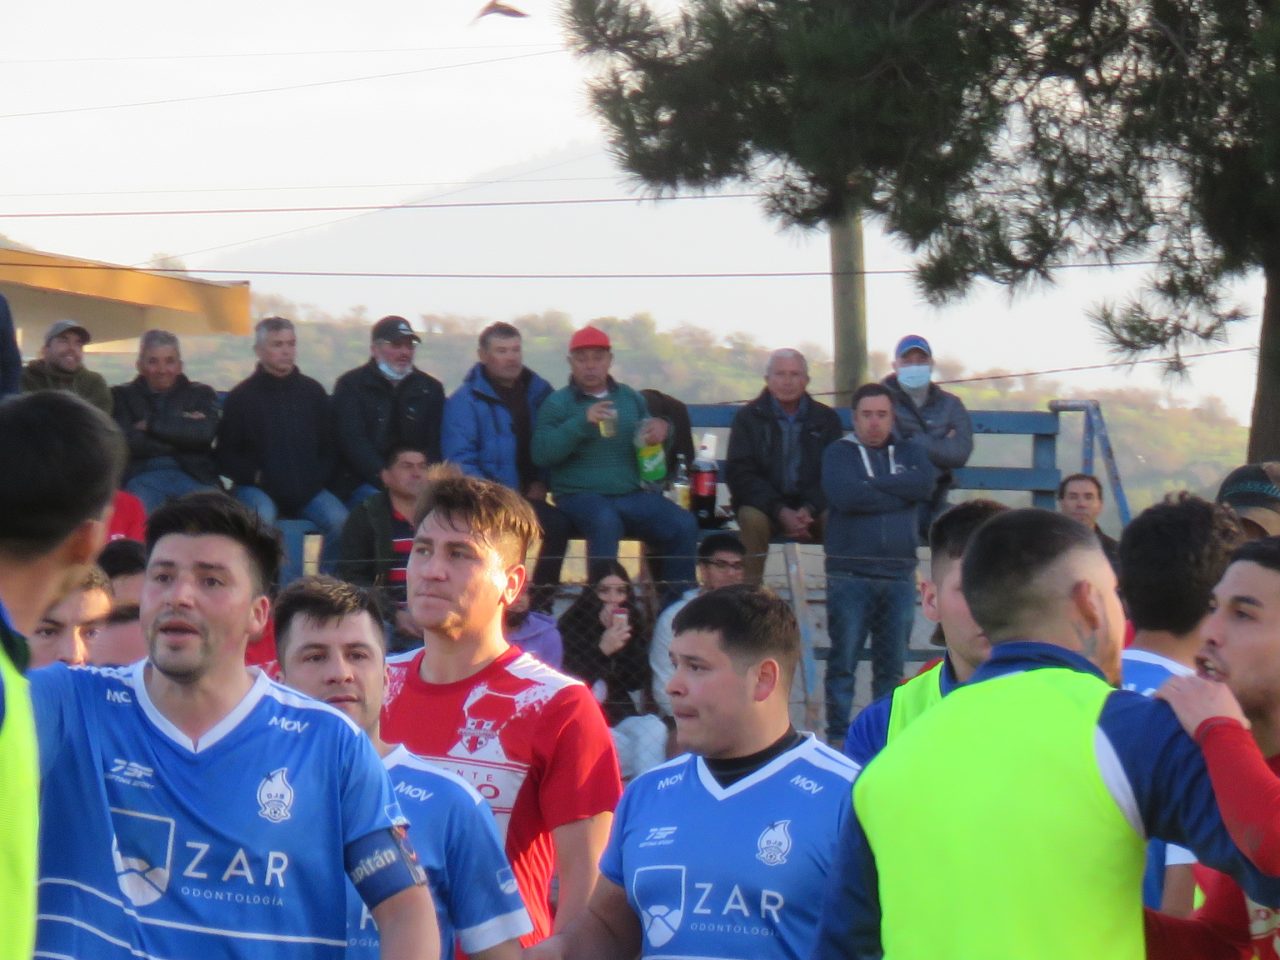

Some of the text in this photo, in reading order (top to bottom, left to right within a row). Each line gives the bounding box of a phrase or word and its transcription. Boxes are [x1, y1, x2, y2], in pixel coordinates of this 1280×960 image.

[268, 716, 310, 734] MOV
[394, 781, 434, 802] MOV
[657, 773, 686, 791] MOV
[790, 775, 823, 795] MOV
[182, 841, 289, 888] ZAR
[692, 882, 785, 924] ZAR
